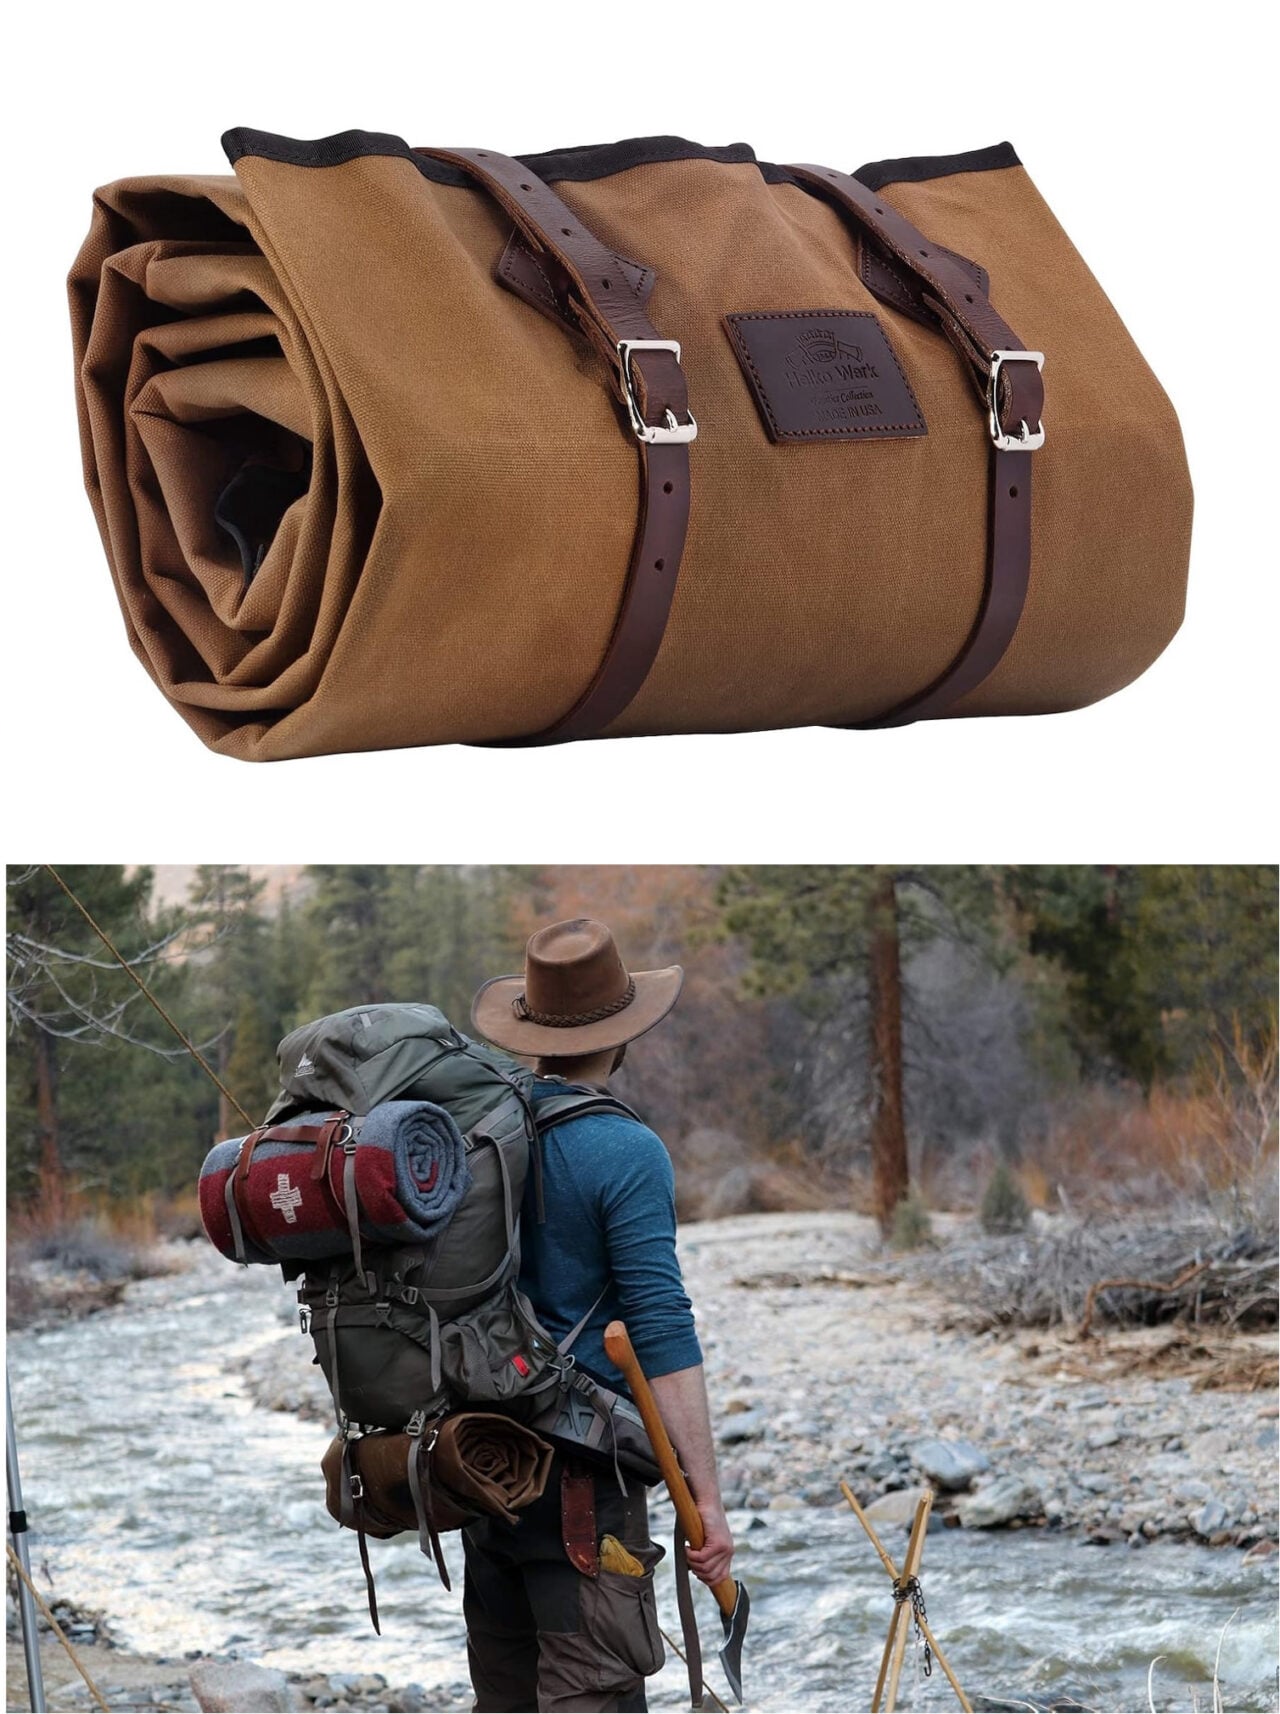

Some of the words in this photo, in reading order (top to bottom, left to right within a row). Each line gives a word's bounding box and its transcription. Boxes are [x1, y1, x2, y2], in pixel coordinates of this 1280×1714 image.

[815, 407, 848, 422] MADE
[848, 405, 860, 418] IN
[860, 403, 883, 417] USA
